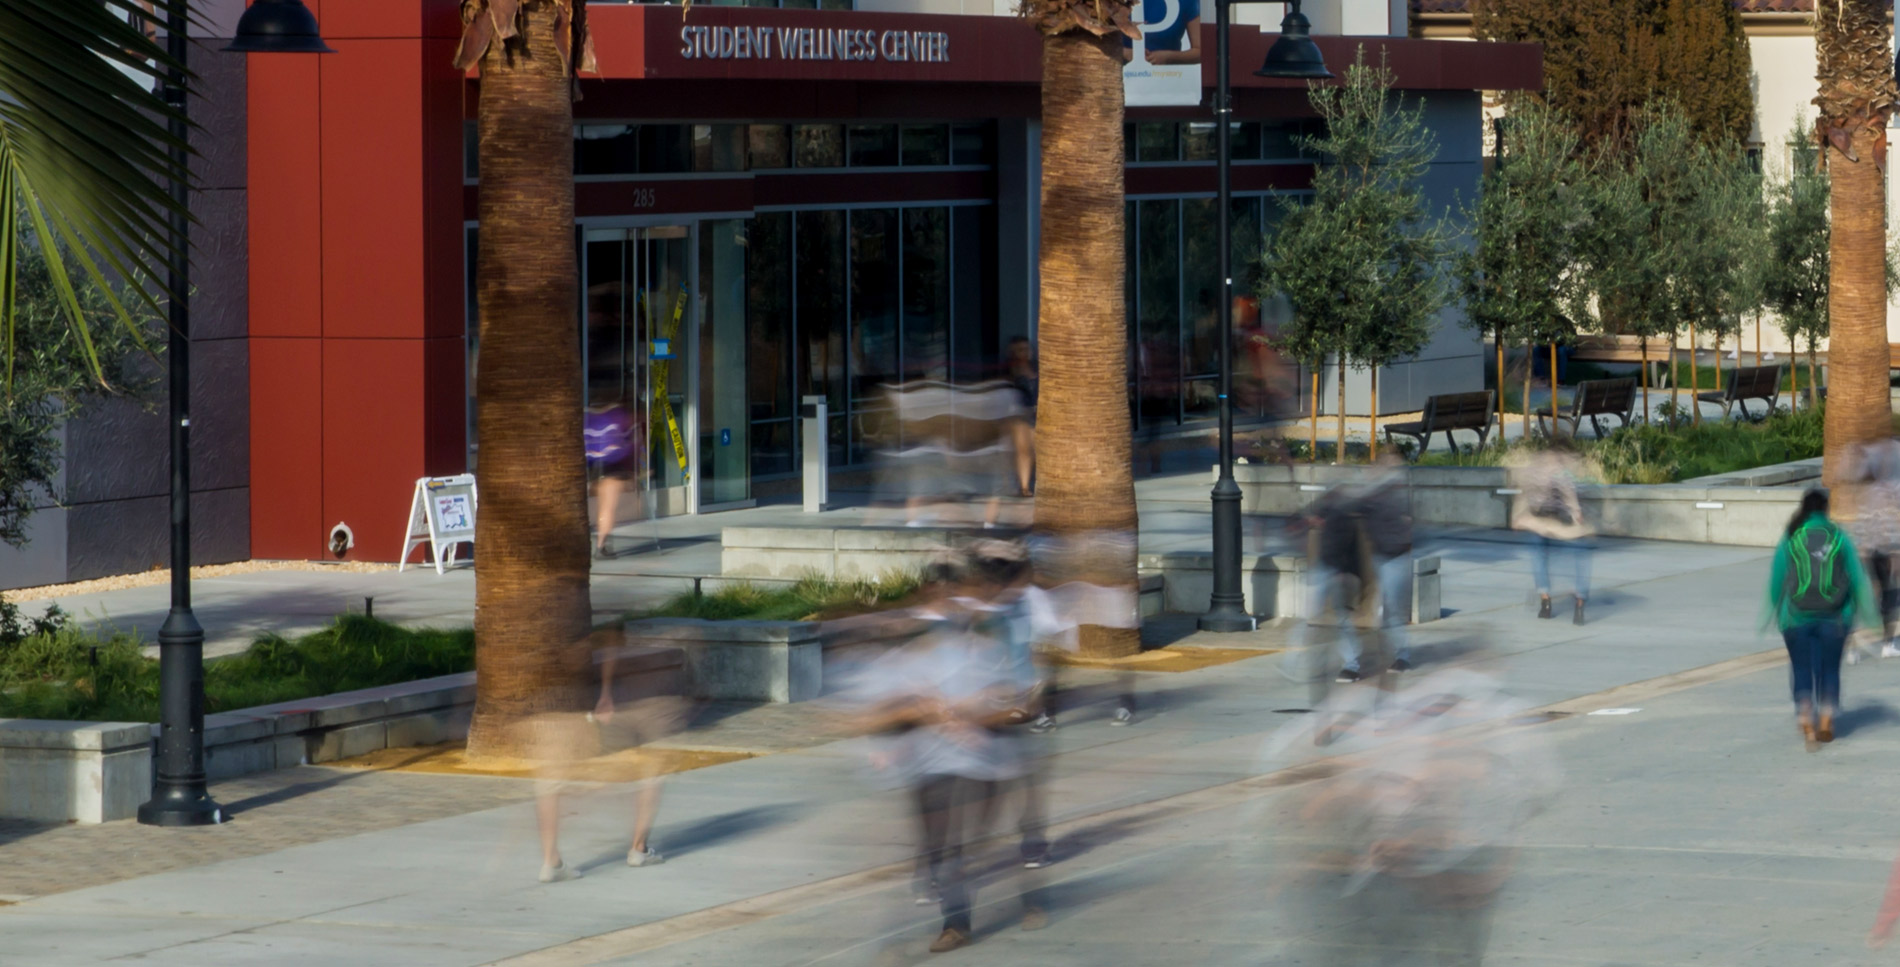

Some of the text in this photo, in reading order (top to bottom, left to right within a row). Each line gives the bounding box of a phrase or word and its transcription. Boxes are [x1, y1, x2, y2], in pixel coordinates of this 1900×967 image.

[681, 25, 950, 62] STUDENT WELLNESS CENTER
[633, 188, 655, 208] 285
[671, 427, 685, 459] CAUTION
